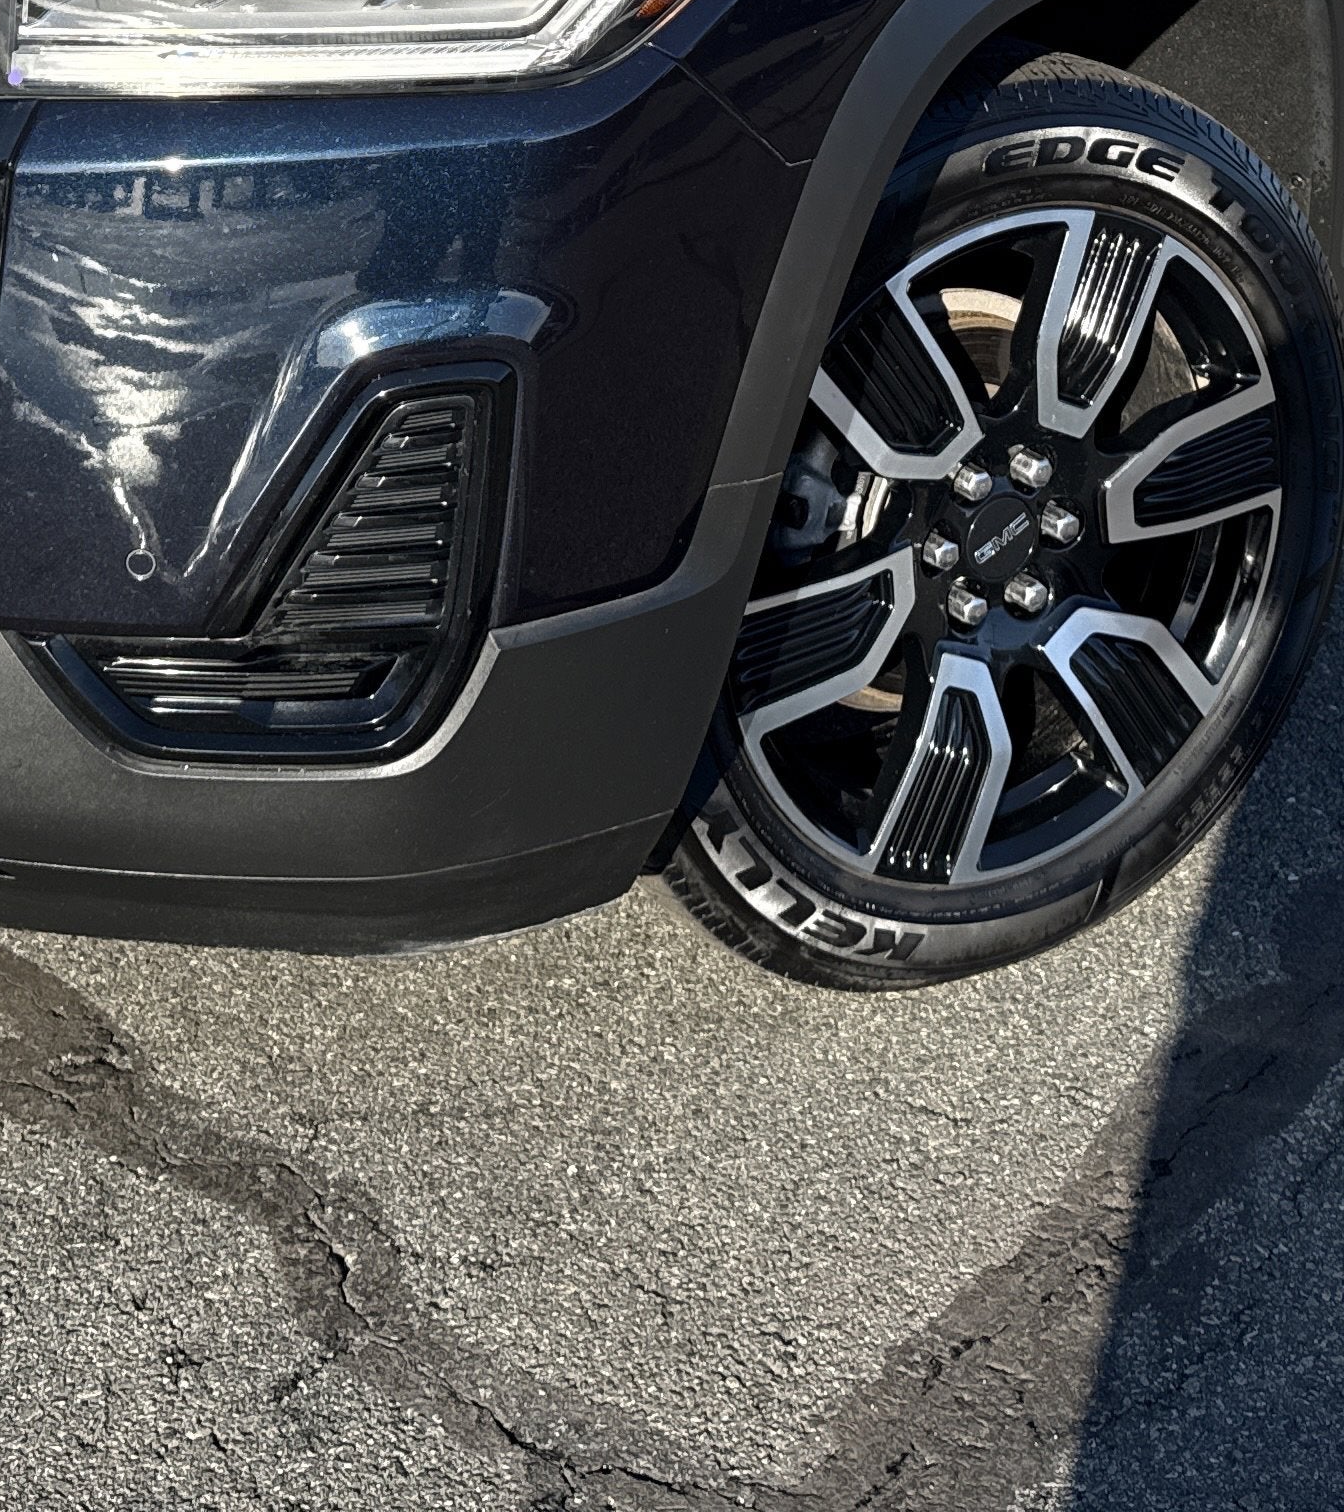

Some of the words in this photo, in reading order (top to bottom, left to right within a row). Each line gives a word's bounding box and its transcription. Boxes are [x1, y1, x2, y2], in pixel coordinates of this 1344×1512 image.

[982, 135, 1187, 183] EDGE
[974, 511, 1030, 565] GMC
[696, 806, 927, 961] KELLY
